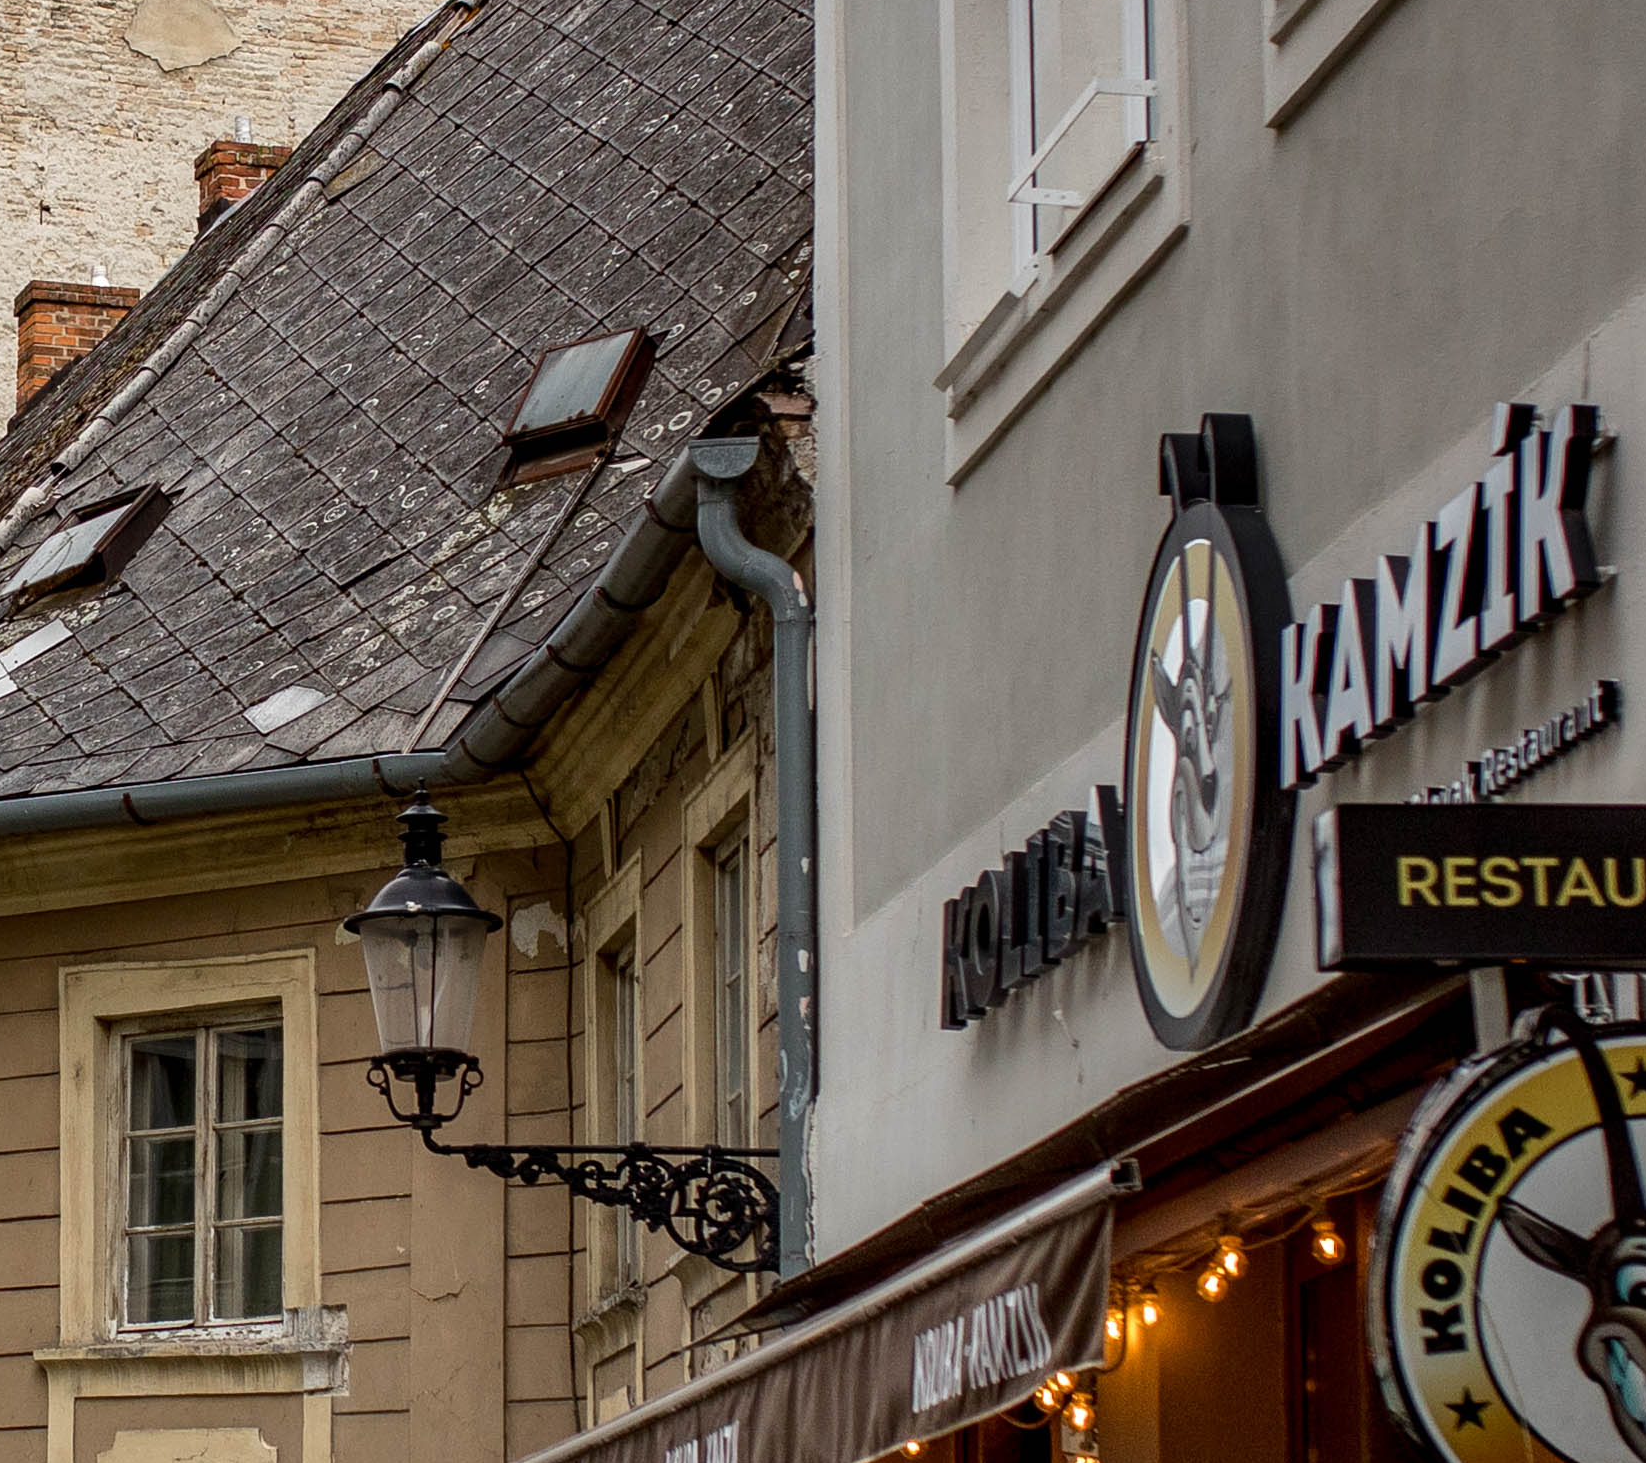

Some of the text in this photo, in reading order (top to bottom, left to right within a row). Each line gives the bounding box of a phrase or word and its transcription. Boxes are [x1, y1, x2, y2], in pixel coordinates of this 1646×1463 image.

[1279, 403, 1600, 791] KAMZÍK
[941, 784, 1128, 1031] KOLIBA
[1421, 1106, 1553, 1356] KOLIBA
